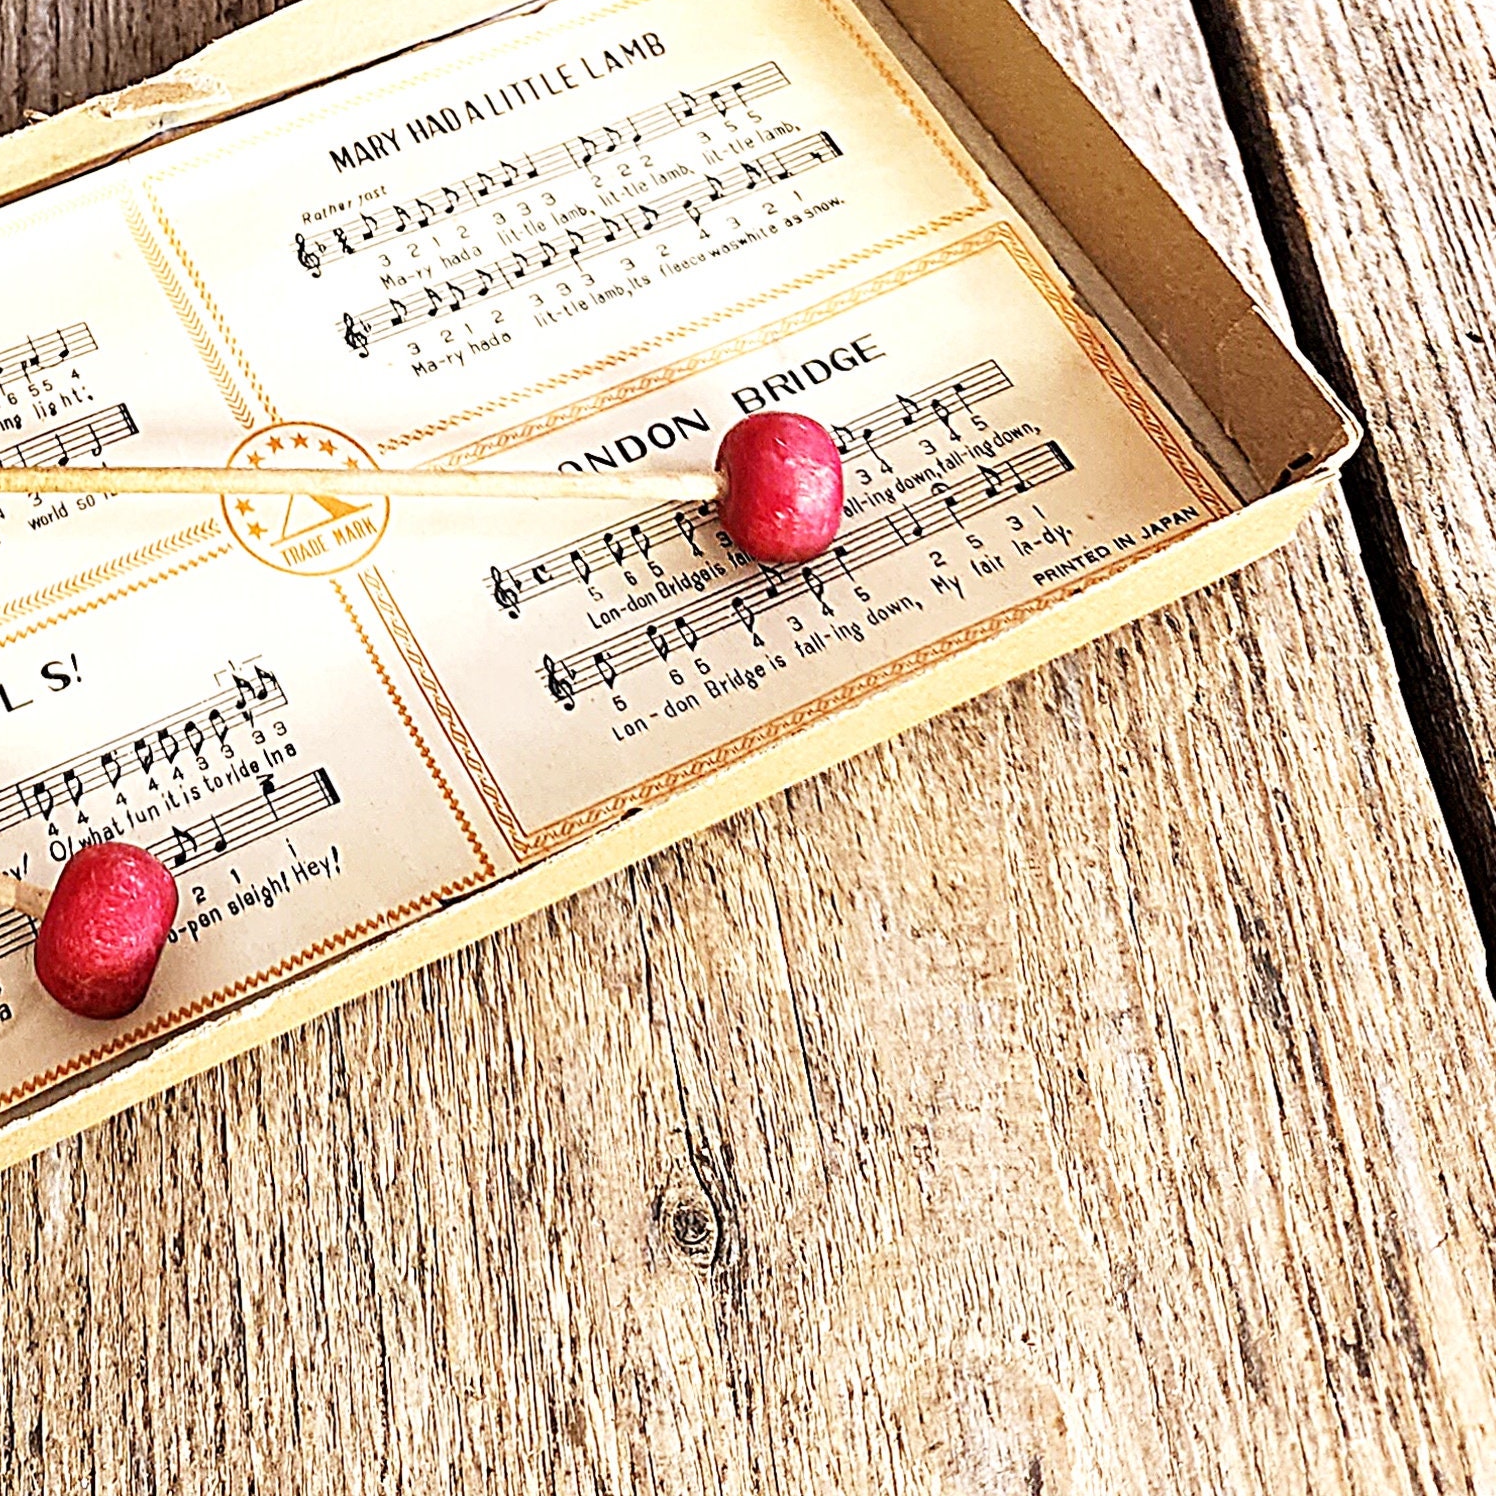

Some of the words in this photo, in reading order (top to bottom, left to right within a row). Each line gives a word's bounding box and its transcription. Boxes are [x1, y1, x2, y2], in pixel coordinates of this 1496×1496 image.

[329, 128, 401, 173] MARY
[484, 64, 579, 116] LITTLE
[581, 32, 666, 79] LAMB
[724, 120, 738, 132] 5
[747, 111, 762, 124] 5
[554, 204, 596, 226] lamb,
[759, 123, 801, 144] lamb,
[411, 351, 465, 377] Ma-ry
[558, 408, 711, 473] NDON
[731, 333, 886, 414] BRIDGE
[27, 502, 68, 531] world
[76, 494, 96, 511] so
[843, 487, 896, 517] all-ing
[280, 534, 329, 567] TRADE
[332, 517, 377, 546] MARK
[1033, 545, 1111, 587] PRINTED
[1112, 533, 1136, 550] IN
[1140, 506, 1200, 539] JAPAN
[612, 695, 627, 711] 5
[669, 669, 684, 686] 6
[787, 616, 804, 631] 3
[821, 604, 834, 616] 4
[854, 586, 870, 602] 5
[929, 551, 946, 568] 2
[966, 535, 983, 549] 5
[1006, 516, 1024, 531] 3
[704, 661, 766, 699] Bridge
[766, 653, 787, 670] is
[866, 596, 924, 626] down,
[930, 575, 965, 600] My
[1012, 524, 1073, 557] la-dy.
[79, 817, 124, 848] what
[162, 790, 180, 810] it
[179, 784, 201, 804] is
[291, 845, 341, 884] Hey!
